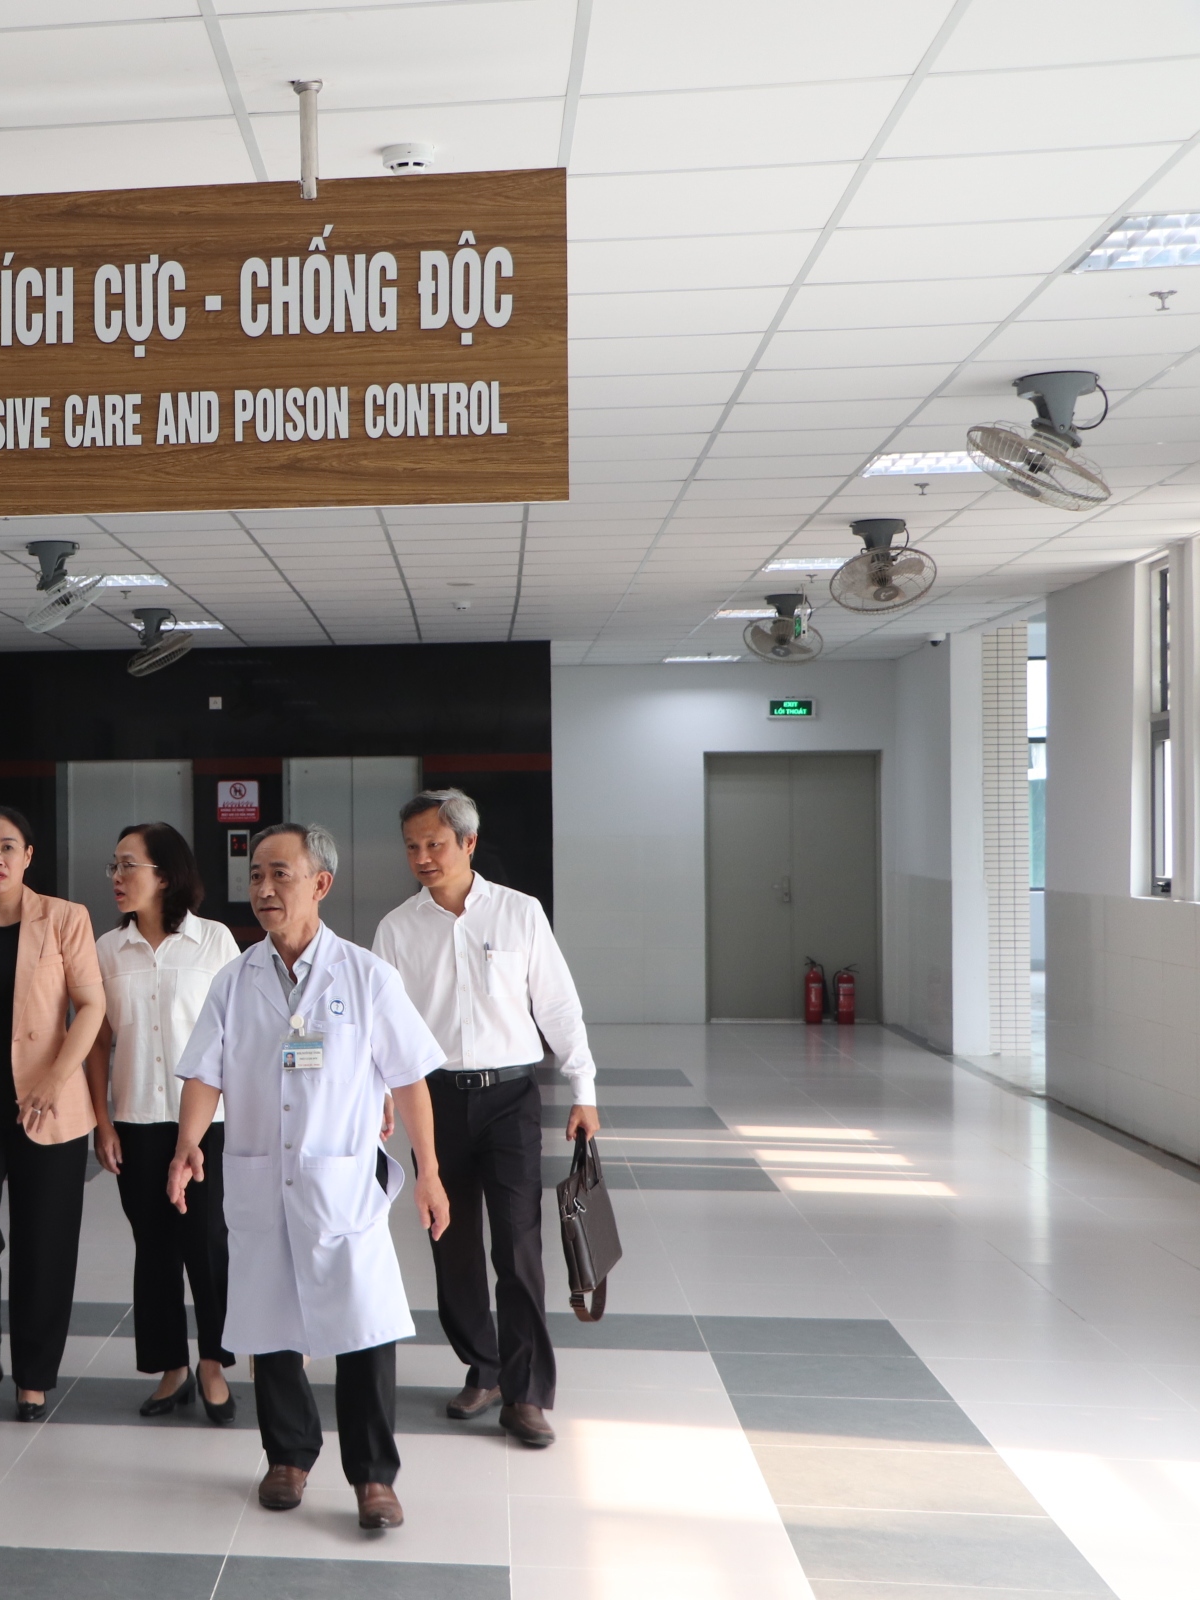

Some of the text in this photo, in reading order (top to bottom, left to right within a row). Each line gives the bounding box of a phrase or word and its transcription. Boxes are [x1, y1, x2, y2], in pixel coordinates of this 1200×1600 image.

[94, 254, 186, 358] CỰC
[205, 295, 222, 311] -
[240, 224, 398, 338] CHỐNG
[417, 230, 514, 346] ĐỘC
[64, 394, 142, 448] CARE
[156, 391, 220, 445] AND
[234, 386, 349, 442] POISON
[364, 380, 508, 439] CONTROL
[786, 707, 807, 715] THOÁT
